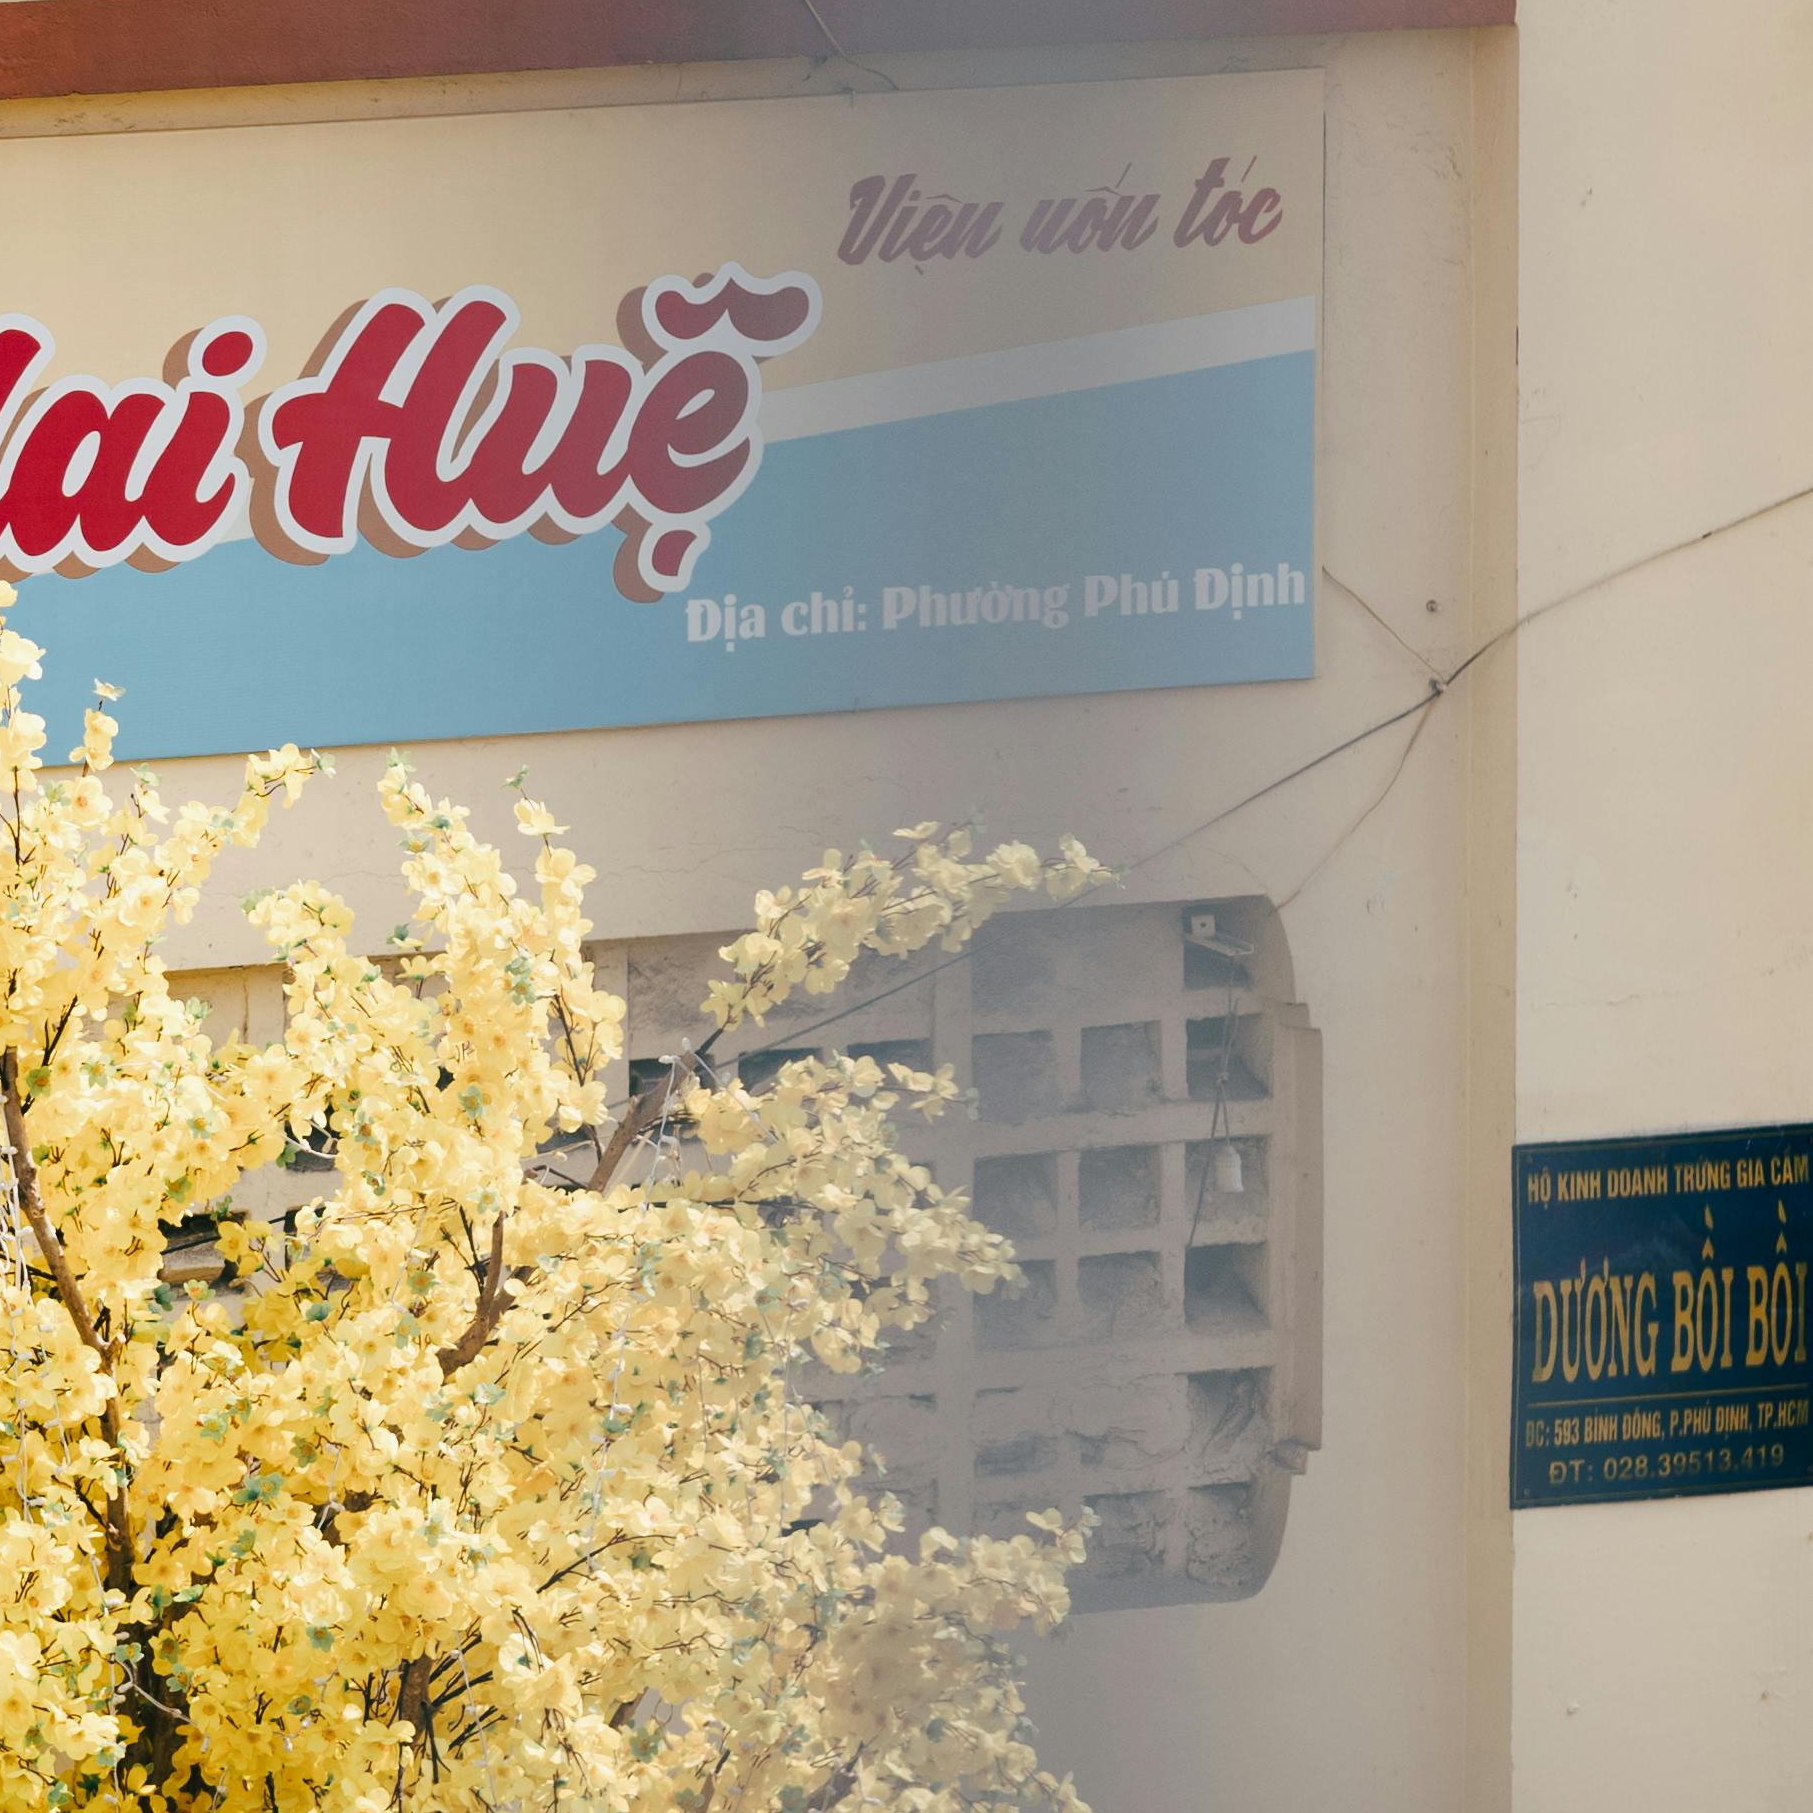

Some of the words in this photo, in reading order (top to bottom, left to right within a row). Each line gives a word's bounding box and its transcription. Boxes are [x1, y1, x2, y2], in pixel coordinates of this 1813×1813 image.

[837, 173, 1005, 276] Viện
[1019, 162, 1161, 255] uốn
[1173, 155, 1284, 249] tóc
[238, 260, 823, 603] Huệ
[687, 593, 766, 652] Địa
[781, 586, 868, 637] chỉ:
[882, 581, 1070, 630] Phường
[1084, 570, 1180, 618] Phú
[1194, 562, 1306, 621] Định
[1527, 1166, 1552, 1210] HỘ
[1557, 1169, 1602, 1203] KINH
[1607, 1163, 1669, 1200] DOANH
[1737, 1156, 1765, 1189] GIA
[1532, 1255, 1660, 1384] DƯƠNG
[1671, 1202, 1735, 1373] BỒI
[1745, 1198, 1808, 1368] BỒI
[1548, 1458, 1594, 1485] ĐT:
[1554, 1416, 1580, 1447] 593
